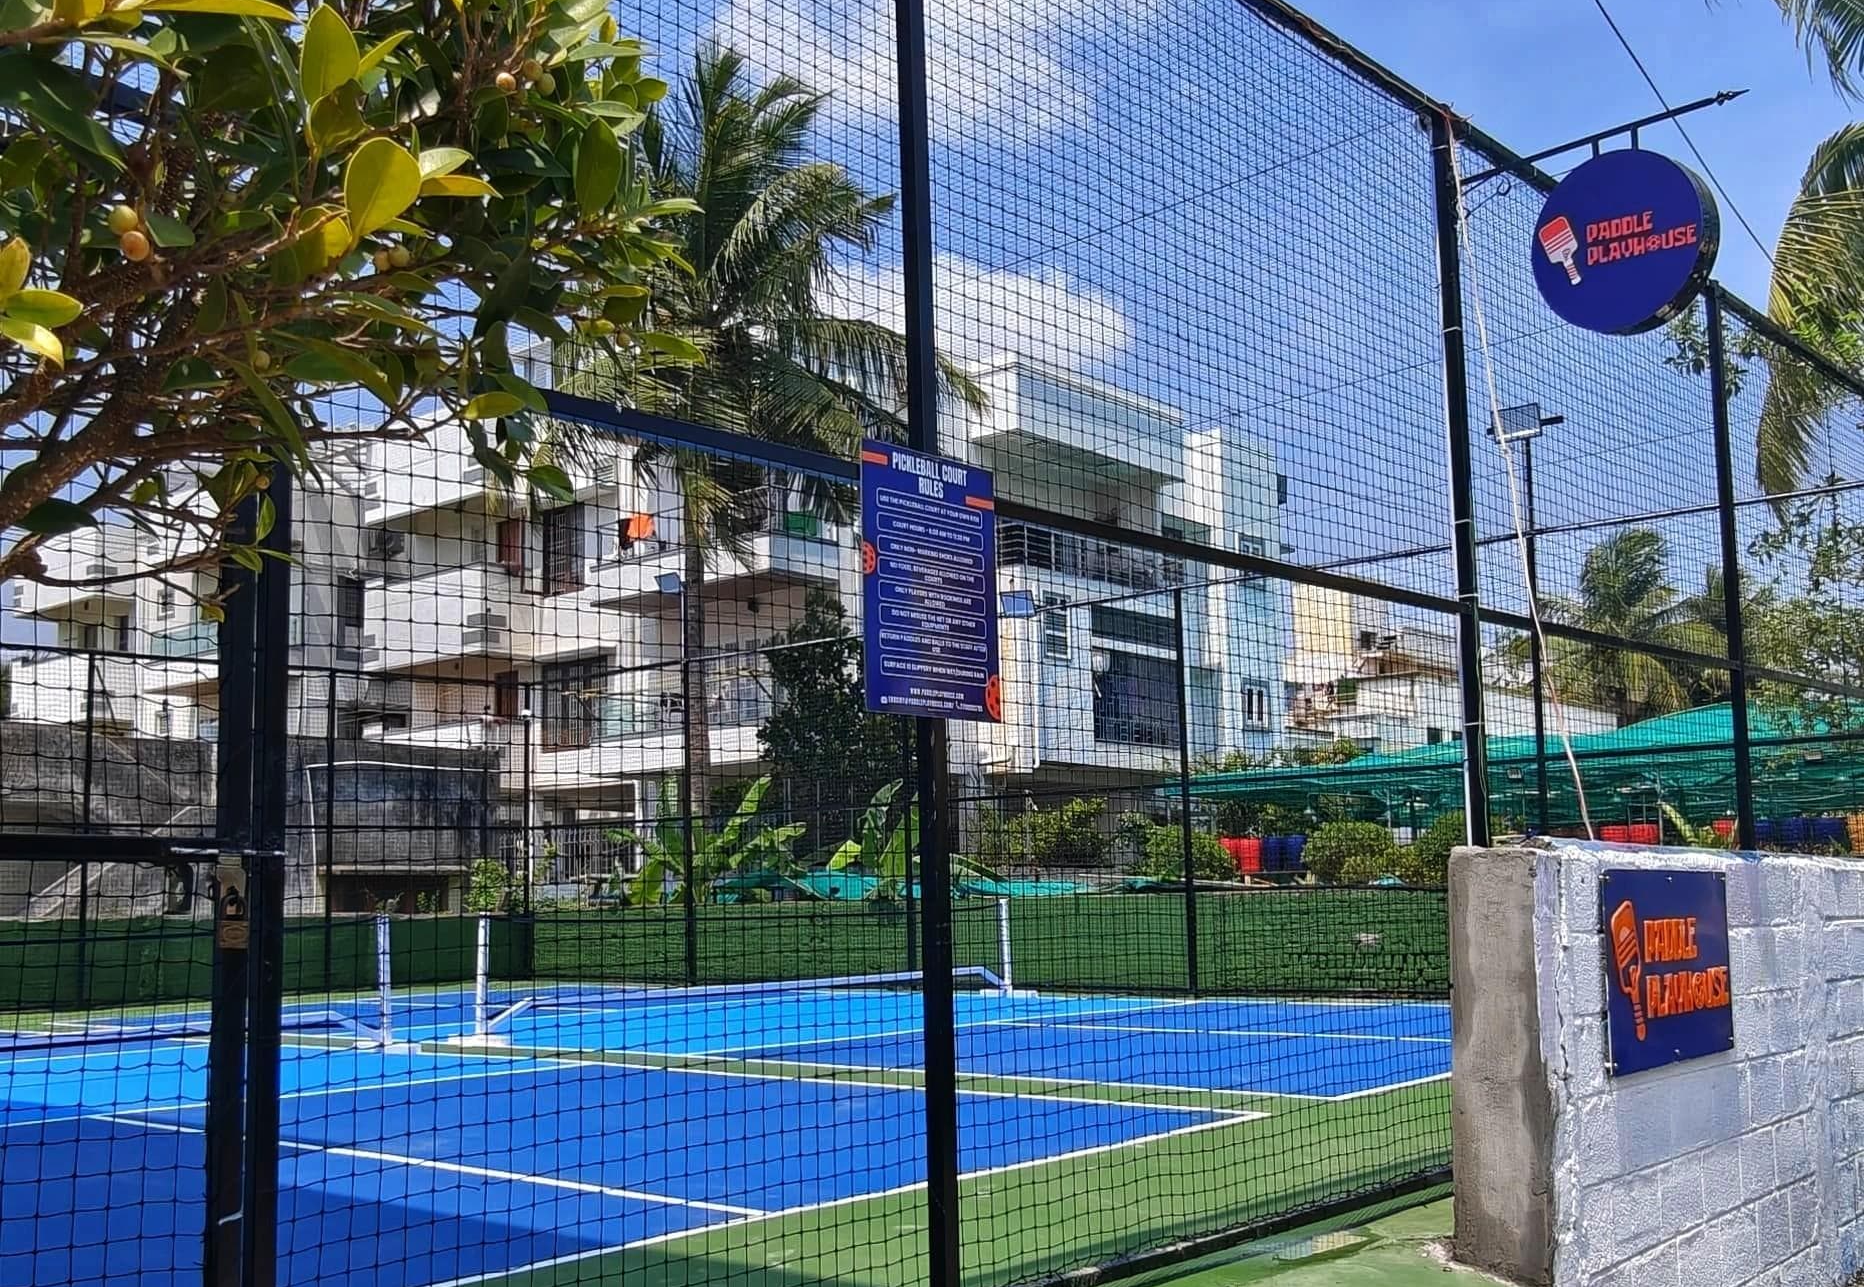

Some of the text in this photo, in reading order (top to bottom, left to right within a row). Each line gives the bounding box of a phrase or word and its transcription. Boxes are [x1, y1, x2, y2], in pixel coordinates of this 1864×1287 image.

[1586, 211, 1653, 243] PADDLE
[1587, 224, 1697, 266] PLAYHOUSE
[892, 452, 967, 487] PICKLEBALL COURT
[918, 477, 944, 498] RULES
[891, 497, 899, 506] THE
[899, 499, 924, 511] PICKLEBALL
[925, 505, 939, 514] COURT
[941, 508, 946, 516] AT
[947, 510, 958, 518] YOUR
[959, 512, 969, 521] OWN
[893, 521, 909, 530] COURT
[910, 524, 925, 533] HOURS
[901, 610, 910, 618] NOT
[952, 618, 961, 626] ANY
[1643, 917, 1698, 963] PADDLE
[1646, 966, 1730, 1019] PLAYHOUSE
